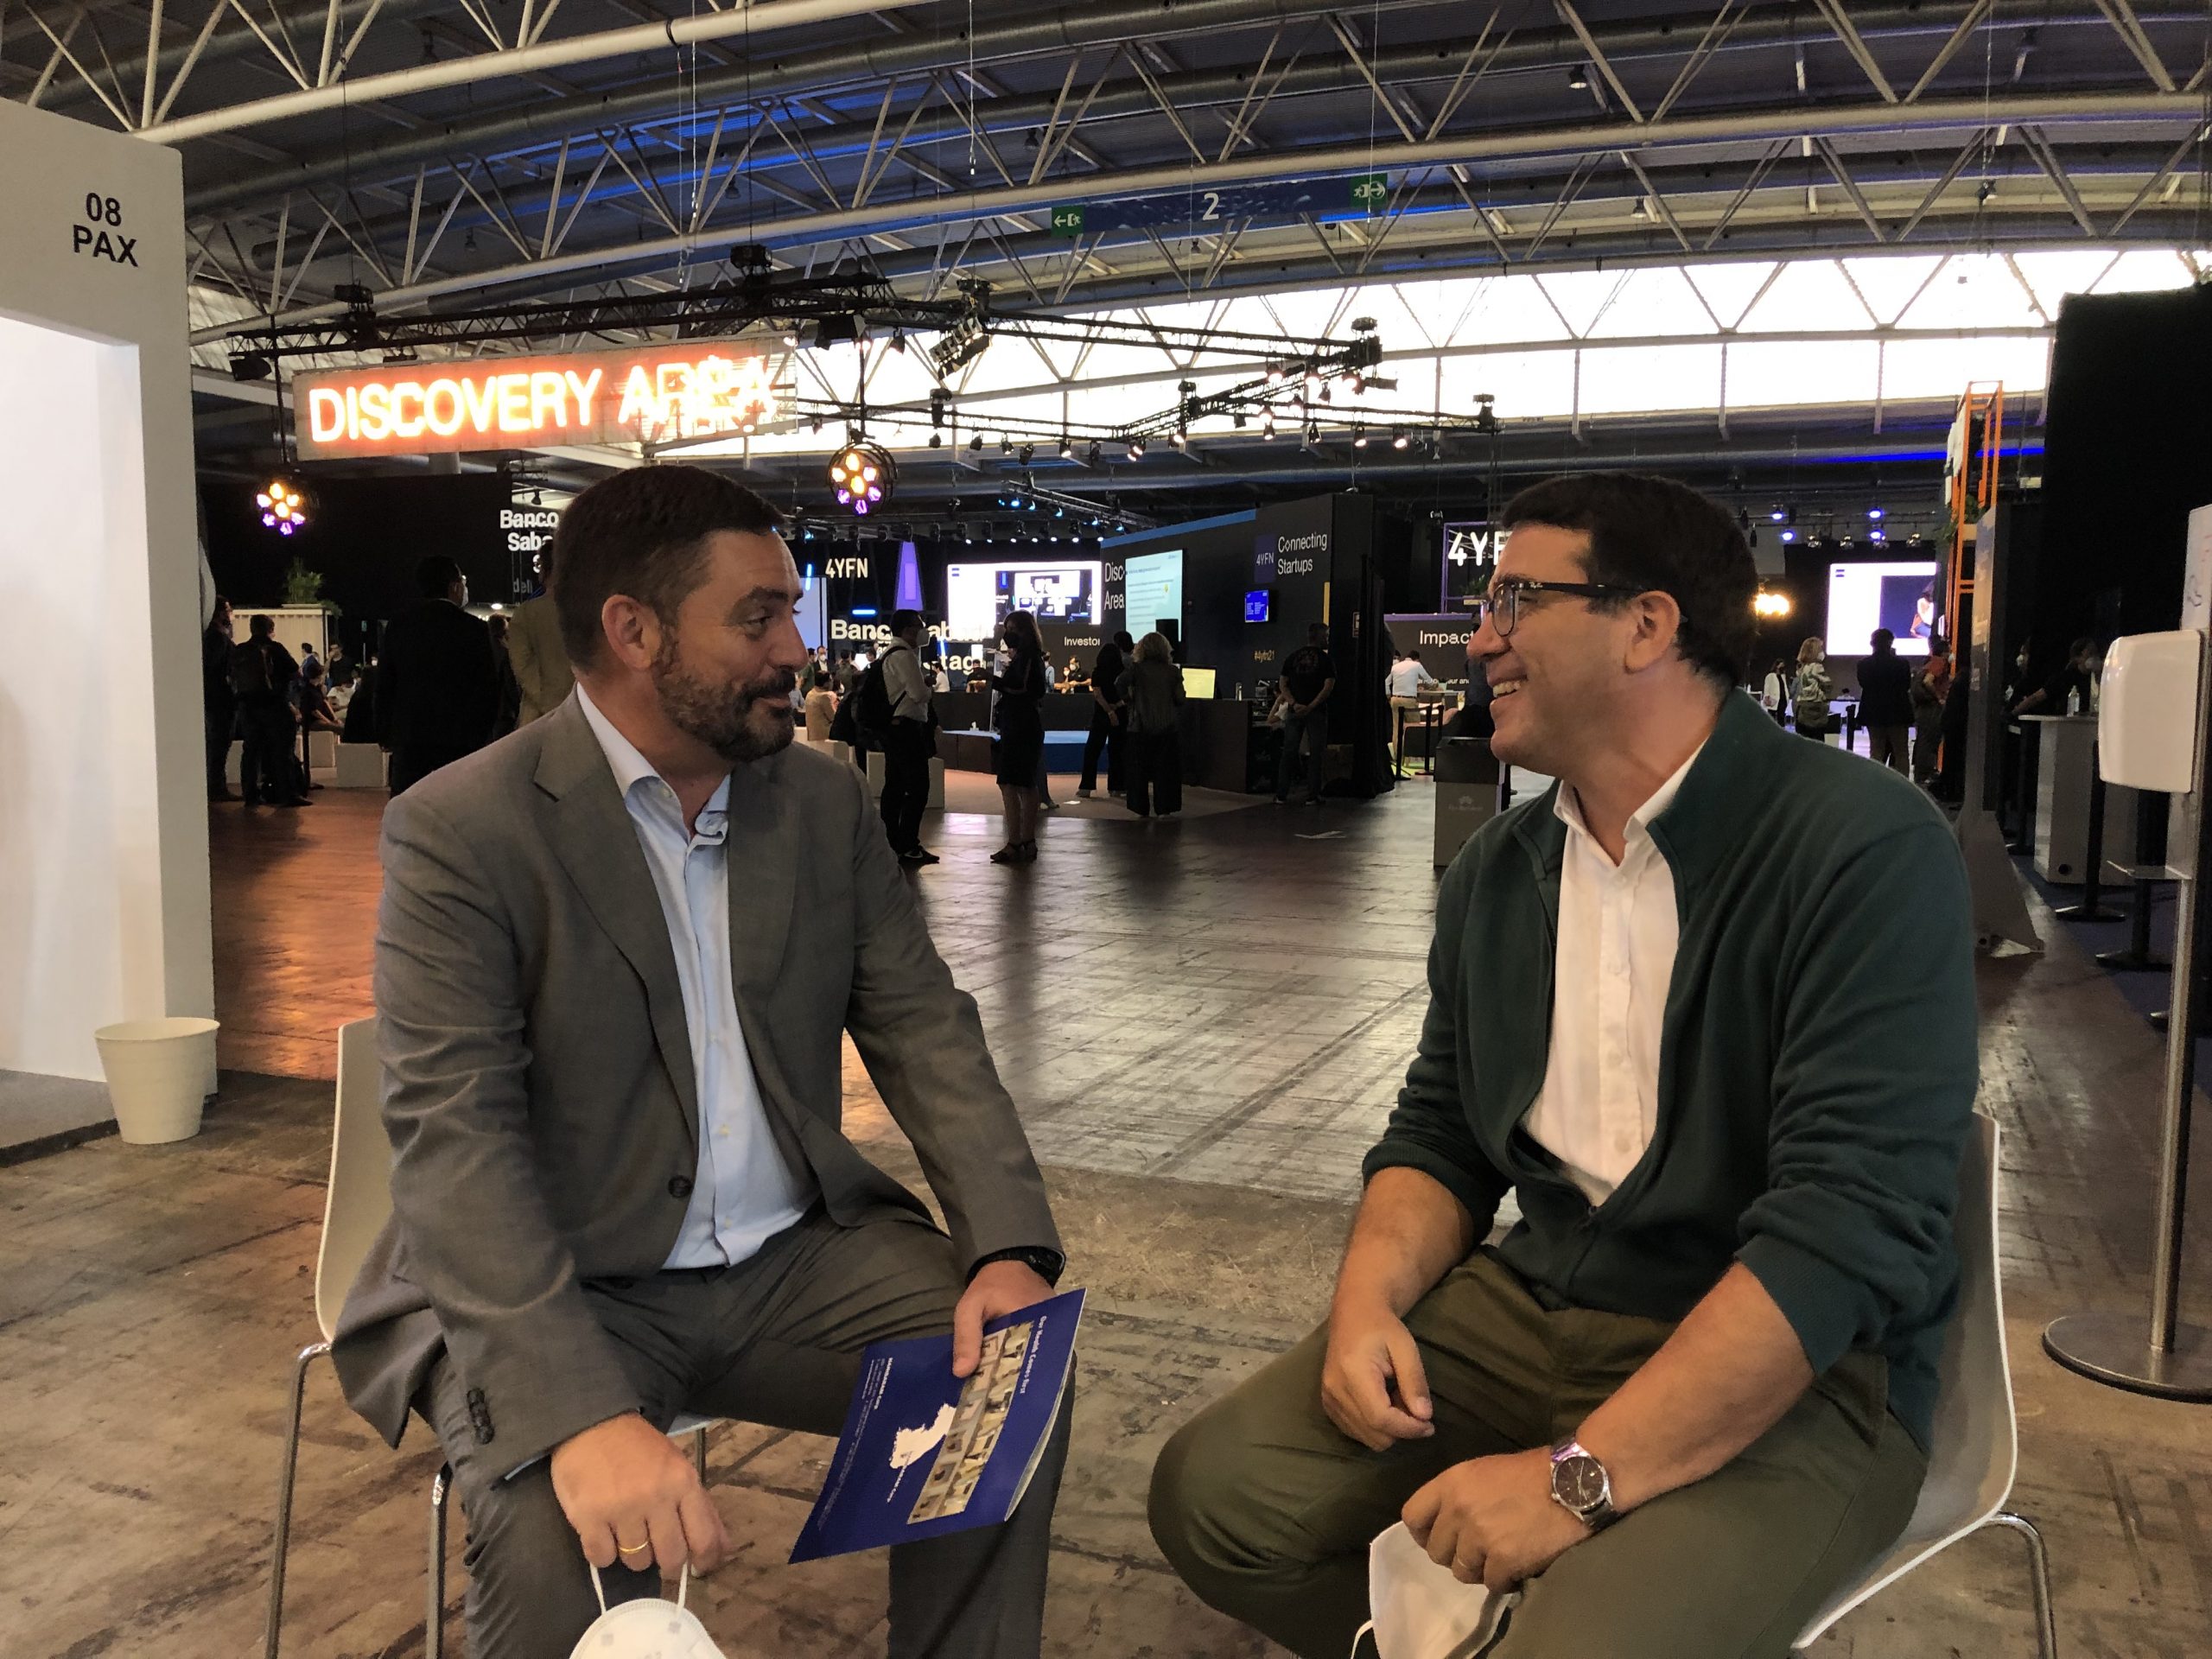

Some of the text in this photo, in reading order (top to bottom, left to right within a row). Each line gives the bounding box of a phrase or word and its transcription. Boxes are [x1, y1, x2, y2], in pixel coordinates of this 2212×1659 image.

[86, 192, 122, 226] 08
[1202, 193, 1219, 220] 2
[73, 225, 138, 267] PAX
[309, 368, 602, 442] DISCOVERY
[500, 510, 559, 529] Banco
[1278, 531, 1327, 553] Connecting
[825, 557, 868, 578] 4YFN
[1255, 551, 1274, 566] 4YFN
[1277, 558, 1313, 575] Startups
[1104, 562, 1127, 582] Disc
[1104, 590, 1124, 610] Area
